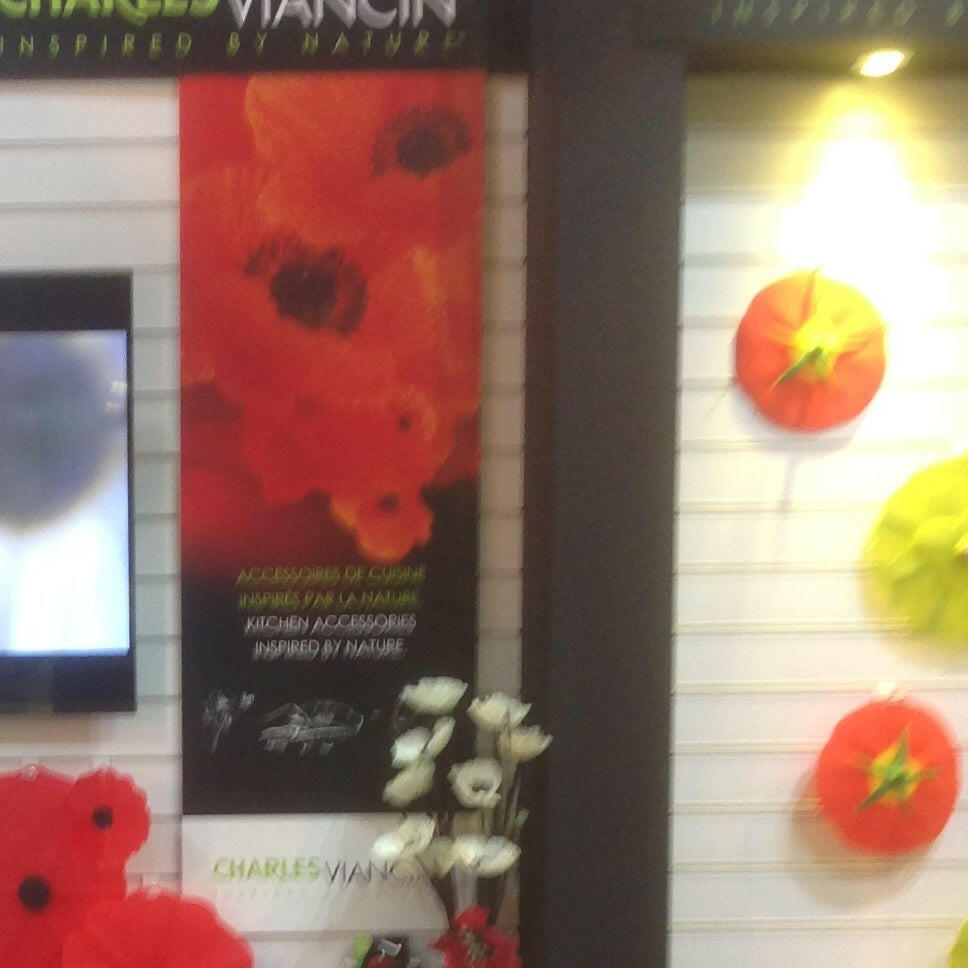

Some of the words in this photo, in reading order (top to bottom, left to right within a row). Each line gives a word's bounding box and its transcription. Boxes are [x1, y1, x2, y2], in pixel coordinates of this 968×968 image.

[226, 33, 269, 57] BY
[235, 565, 341, 586] ACCESSOIRES
[344, 565, 366, 584] DE
[368, 564, 427, 584] CUISINE
[303, 590, 336, 607] PAR
[338, 590, 357, 606] LA
[360, 589, 419, 607] NATURE
[245, 615, 309, 634] KITCHEN
[311, 613, 417, 634] ACCESSORIES
[253, 639, 320, 658] INSPIRED
[322, 639, 342, 658] BY
[345, 637, 406, 657] NATURE
